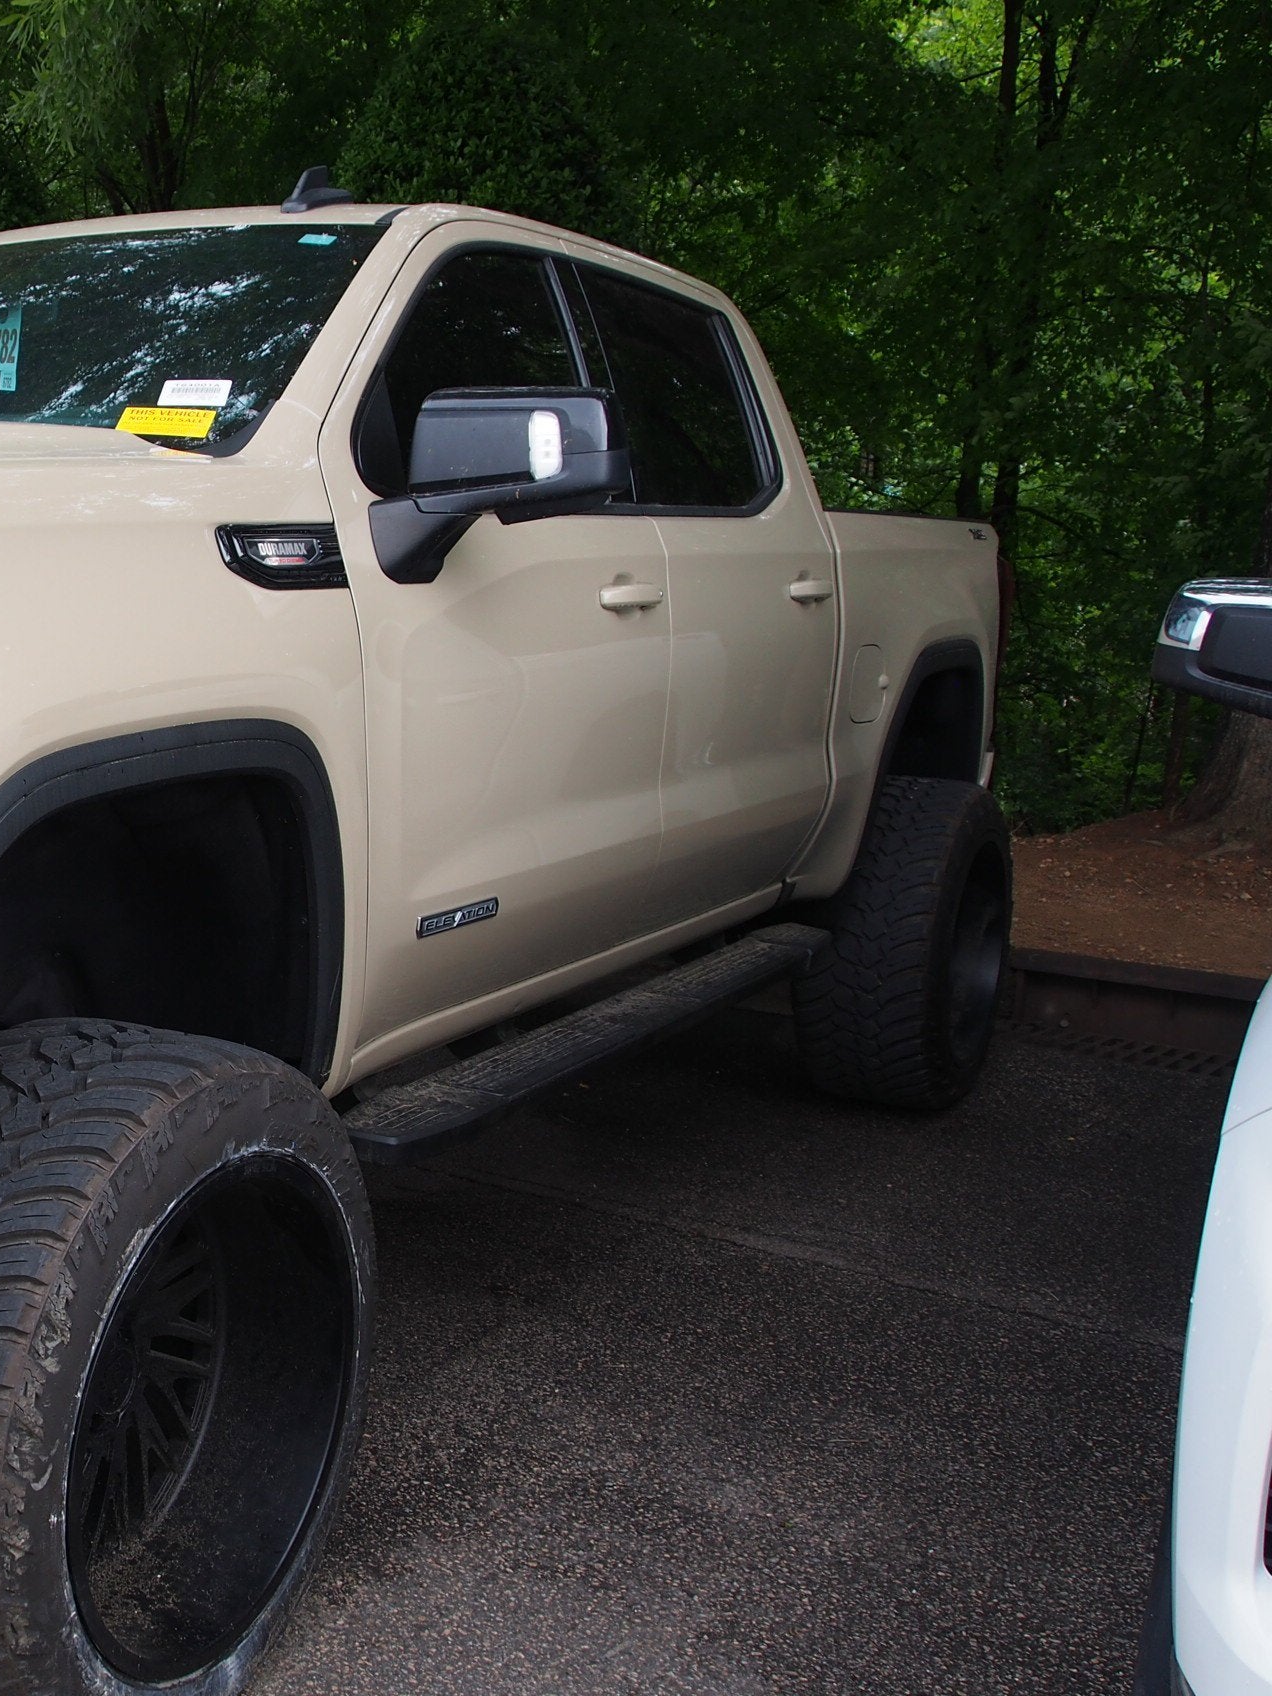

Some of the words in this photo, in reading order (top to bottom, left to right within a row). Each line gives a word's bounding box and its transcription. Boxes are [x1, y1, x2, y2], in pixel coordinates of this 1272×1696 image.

[160, 410, 212, 418] VEHICLE
[258, 543, 307, 556] DURAMAX
[425, 903, 495, 930] ELEVATION
